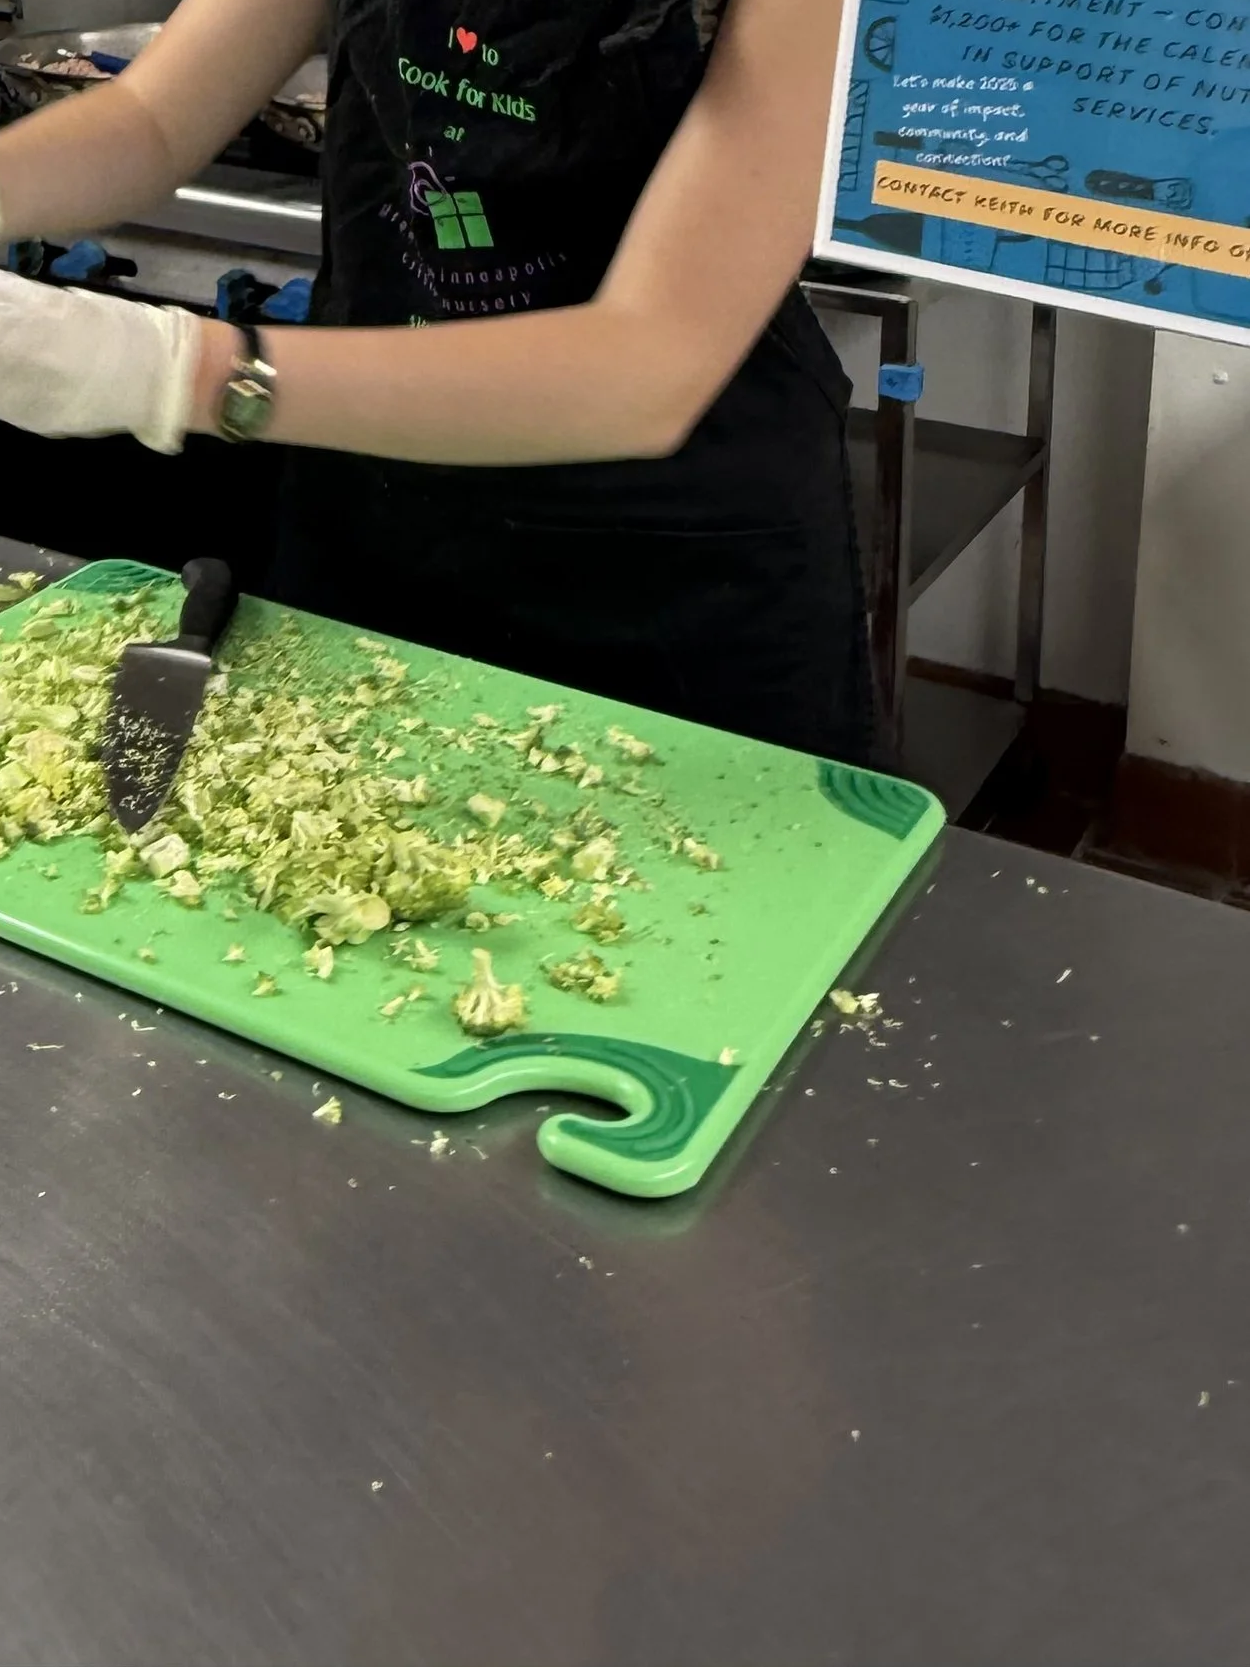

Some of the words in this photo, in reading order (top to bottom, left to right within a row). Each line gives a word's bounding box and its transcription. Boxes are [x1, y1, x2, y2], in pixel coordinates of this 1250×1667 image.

[1185, 9, 1248, 32] CON
[1029, 21, 1085, 44] FOR
[1098, 31, 1152, 54] THE
[398, 57, 450, 97] Cook
[456, 78, 486, 108] for
[932, 74, 975, 90] make
[962, 45, 993, 63] IN
[1002, 51, 1135, 85] SUPPORT
[1143, 73, 1185, 92] OF
[902, 102, 937, 118] year
[941, 98, 960, 118] of
[1073, 97, 1219, 136] SERVICES.
[994, 128, 1029, 142] and
[877, 176, 968, 203] CONTACT
[974, 195, 1034, 216] KEITH
[1043, 206, 1085, 227] FOR
[1093, 217, 1158, 241] MORE
[1165, 233, 1220, 253] INFO
